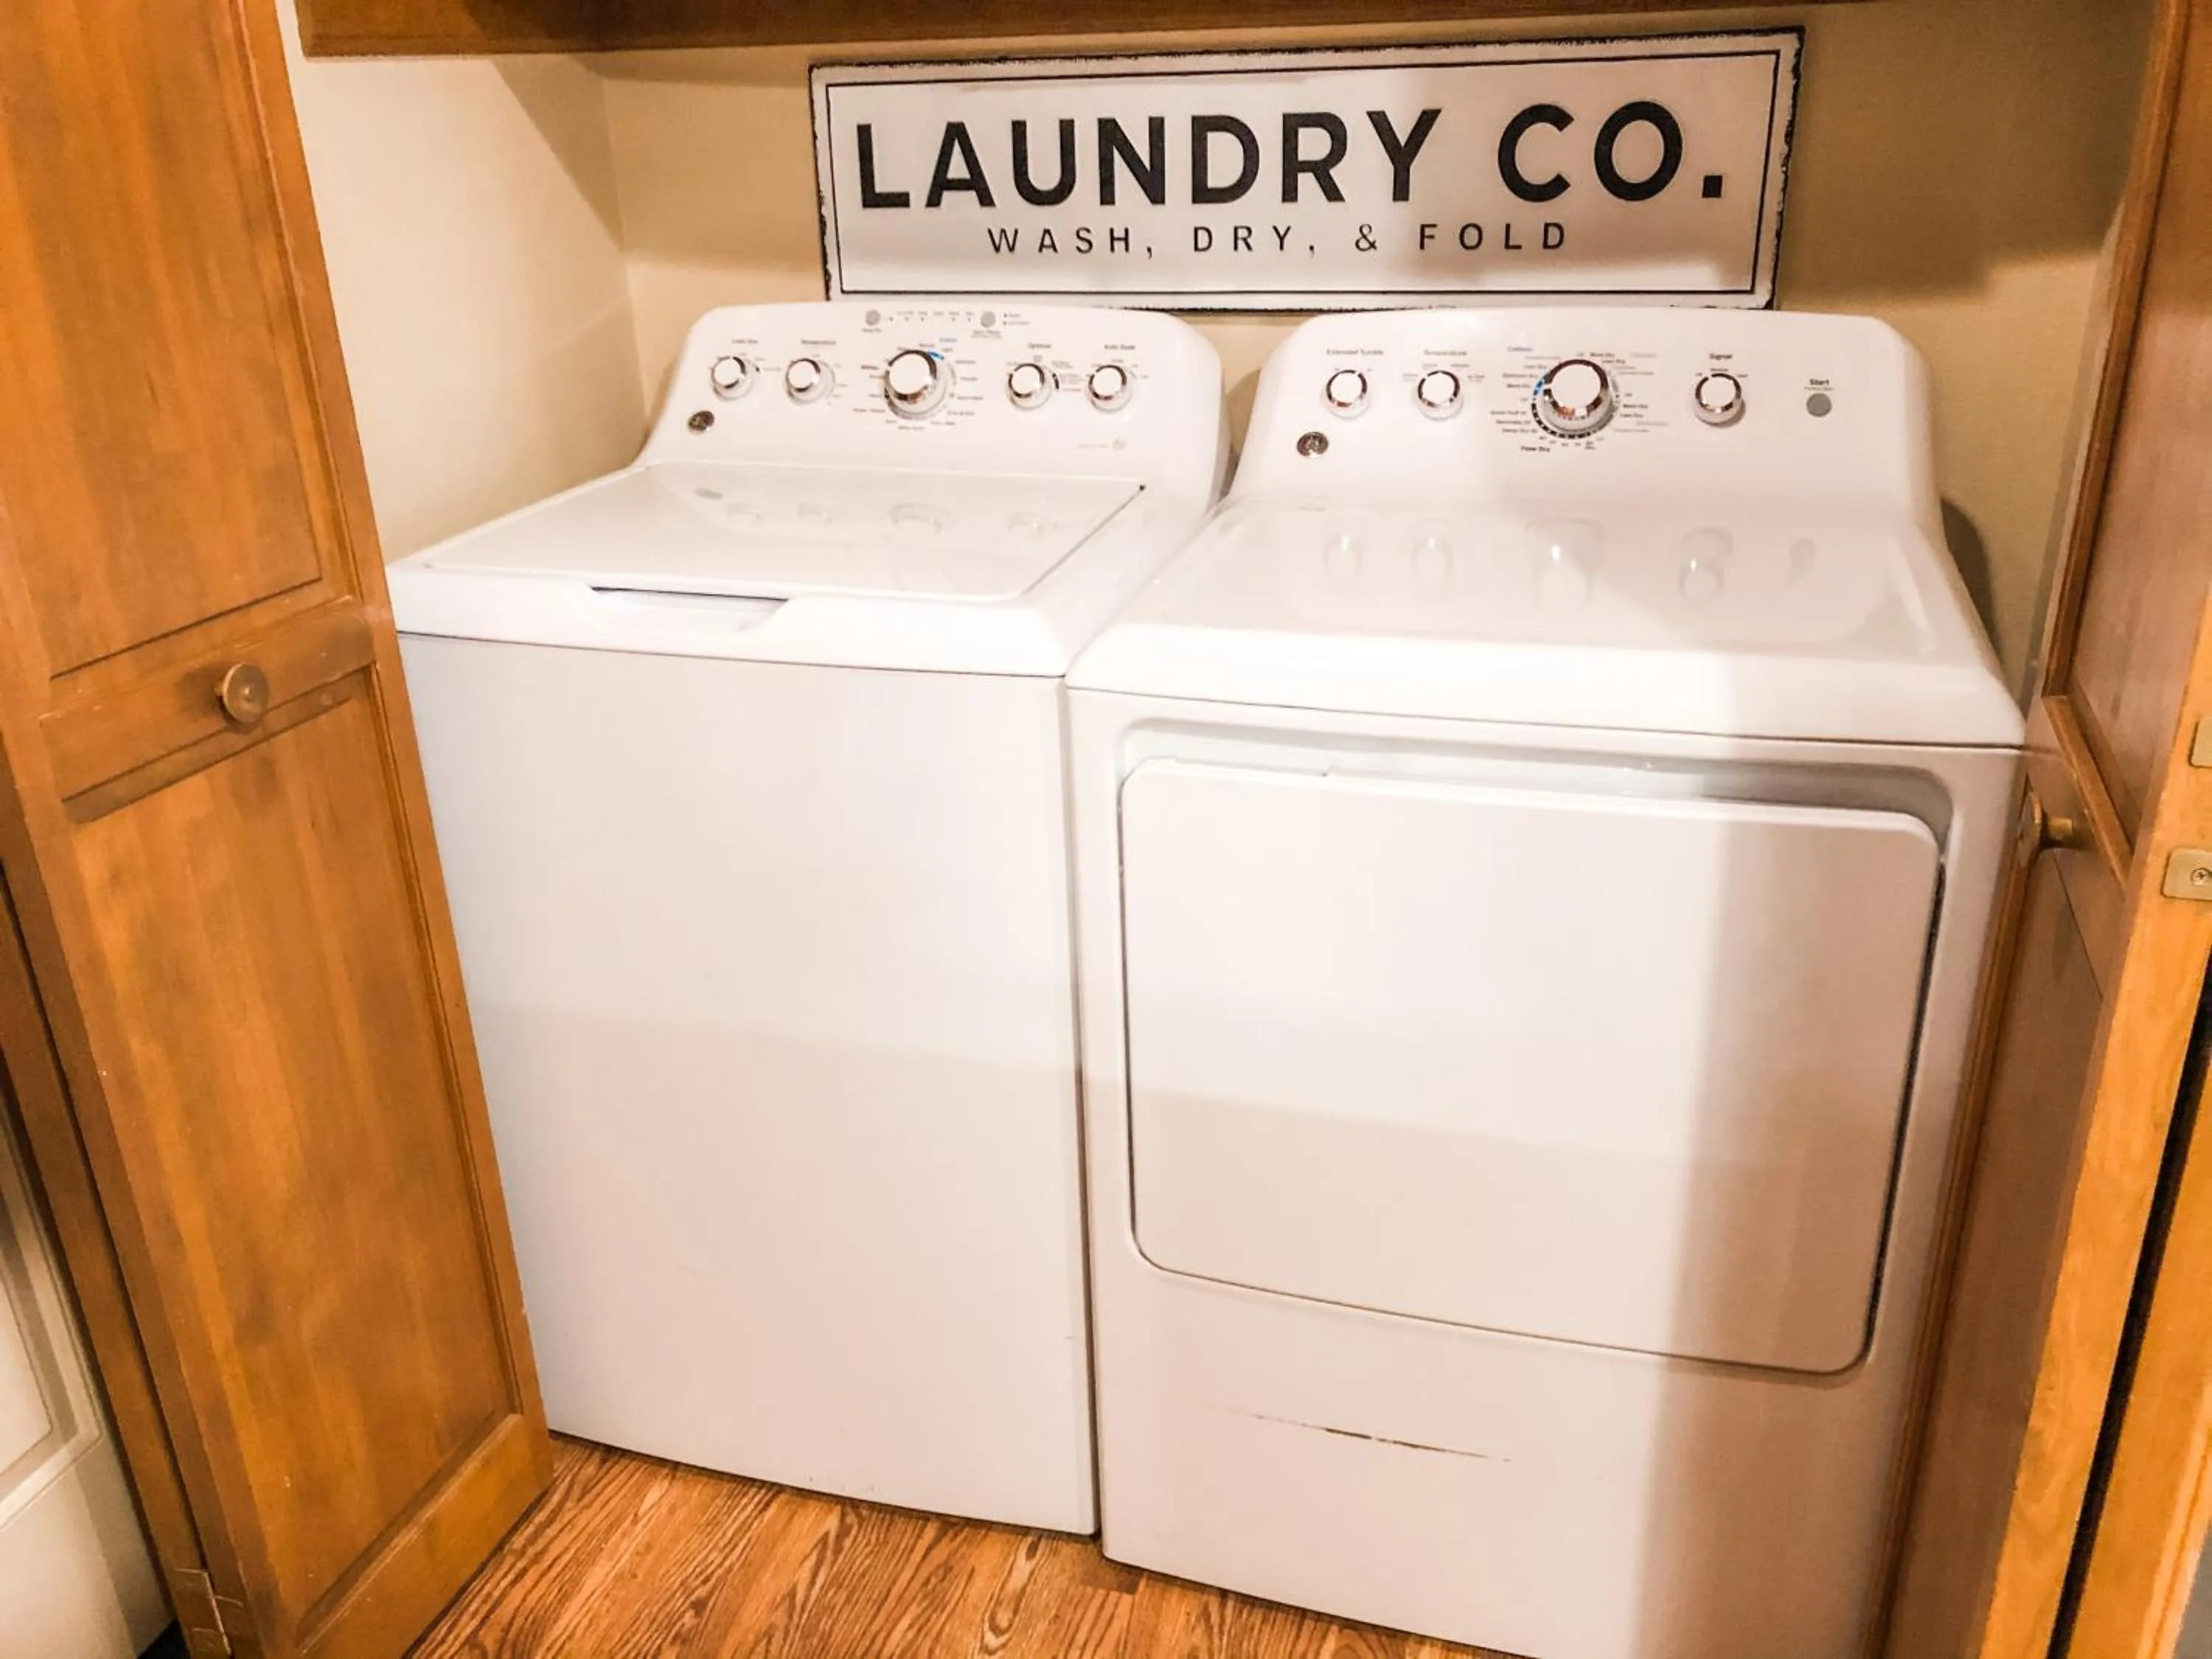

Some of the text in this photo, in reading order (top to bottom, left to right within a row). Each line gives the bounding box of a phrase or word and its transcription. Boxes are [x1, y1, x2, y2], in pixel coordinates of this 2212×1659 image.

[856, 100, 1724, 209] LAUNDRY CO.
[987, 222, 1566, 260] WASH, DRY, & FOLD
